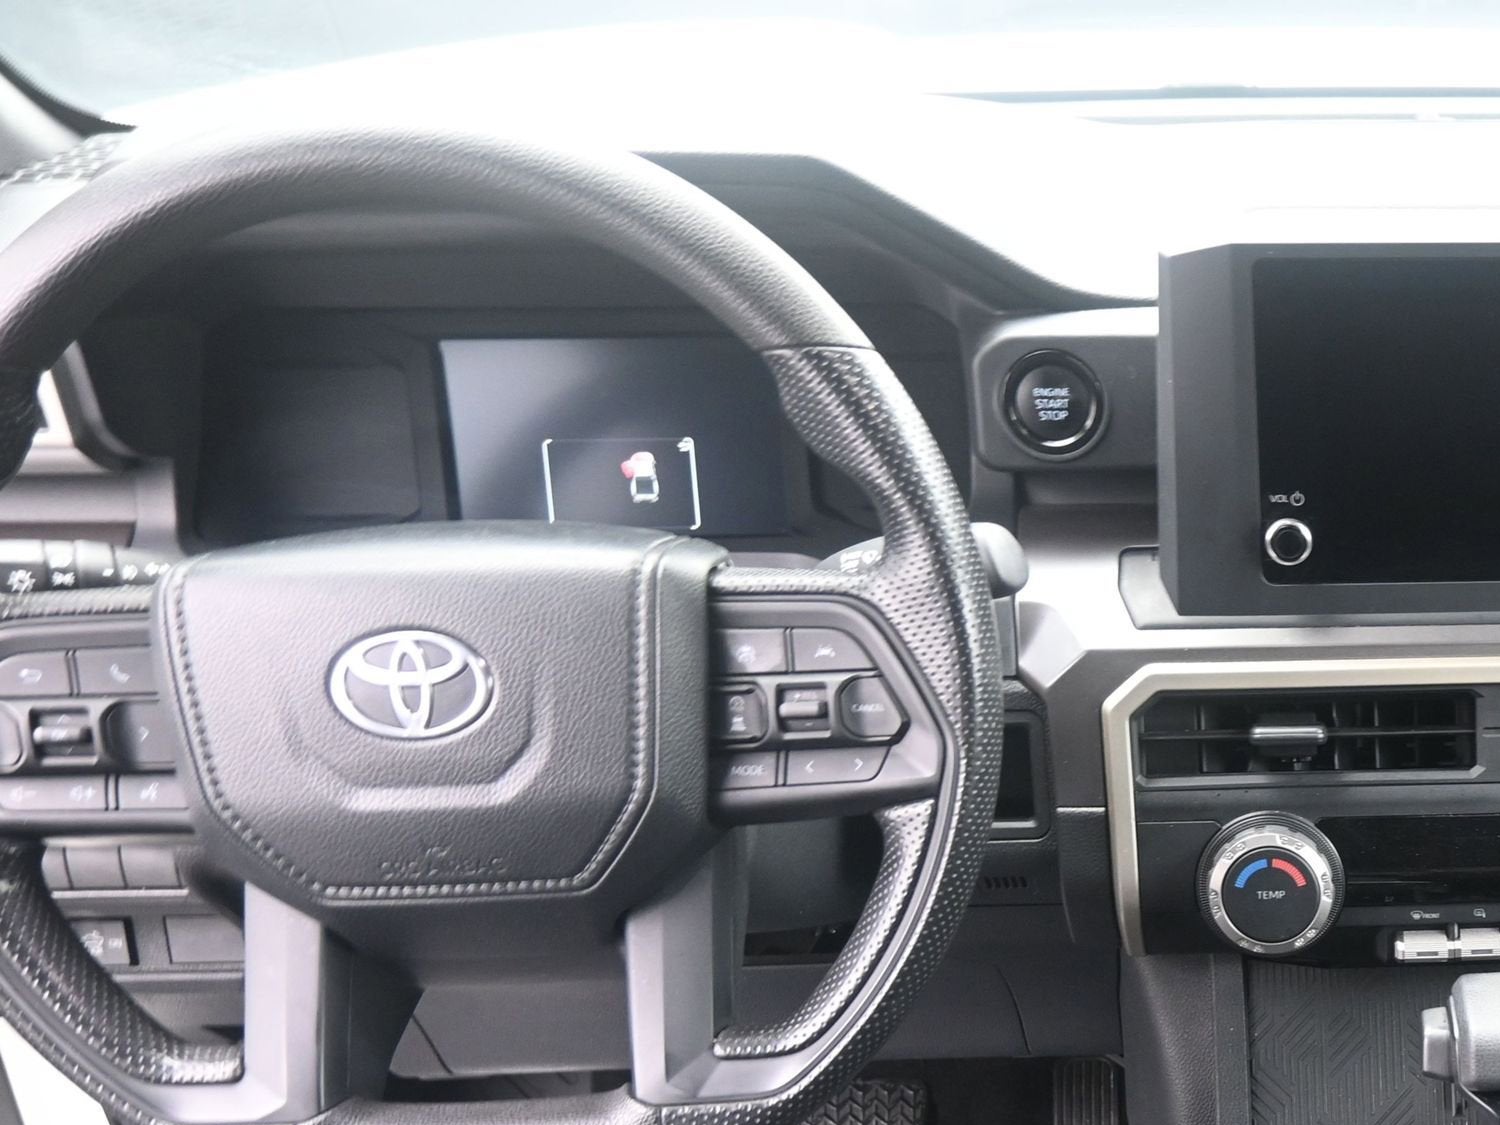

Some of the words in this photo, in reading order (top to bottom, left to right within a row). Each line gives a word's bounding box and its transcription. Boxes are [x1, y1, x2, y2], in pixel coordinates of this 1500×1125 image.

[1032, 387, 1070, 397] ENGINE
[1034, 398, 1070, 409] START
[1039, 410, 1069, 420] STOP
[1269, 494, 1289, 503] VOL
[731, 765, 766, 775] MODE
[1256, 890, 1286, 900] TEMP
